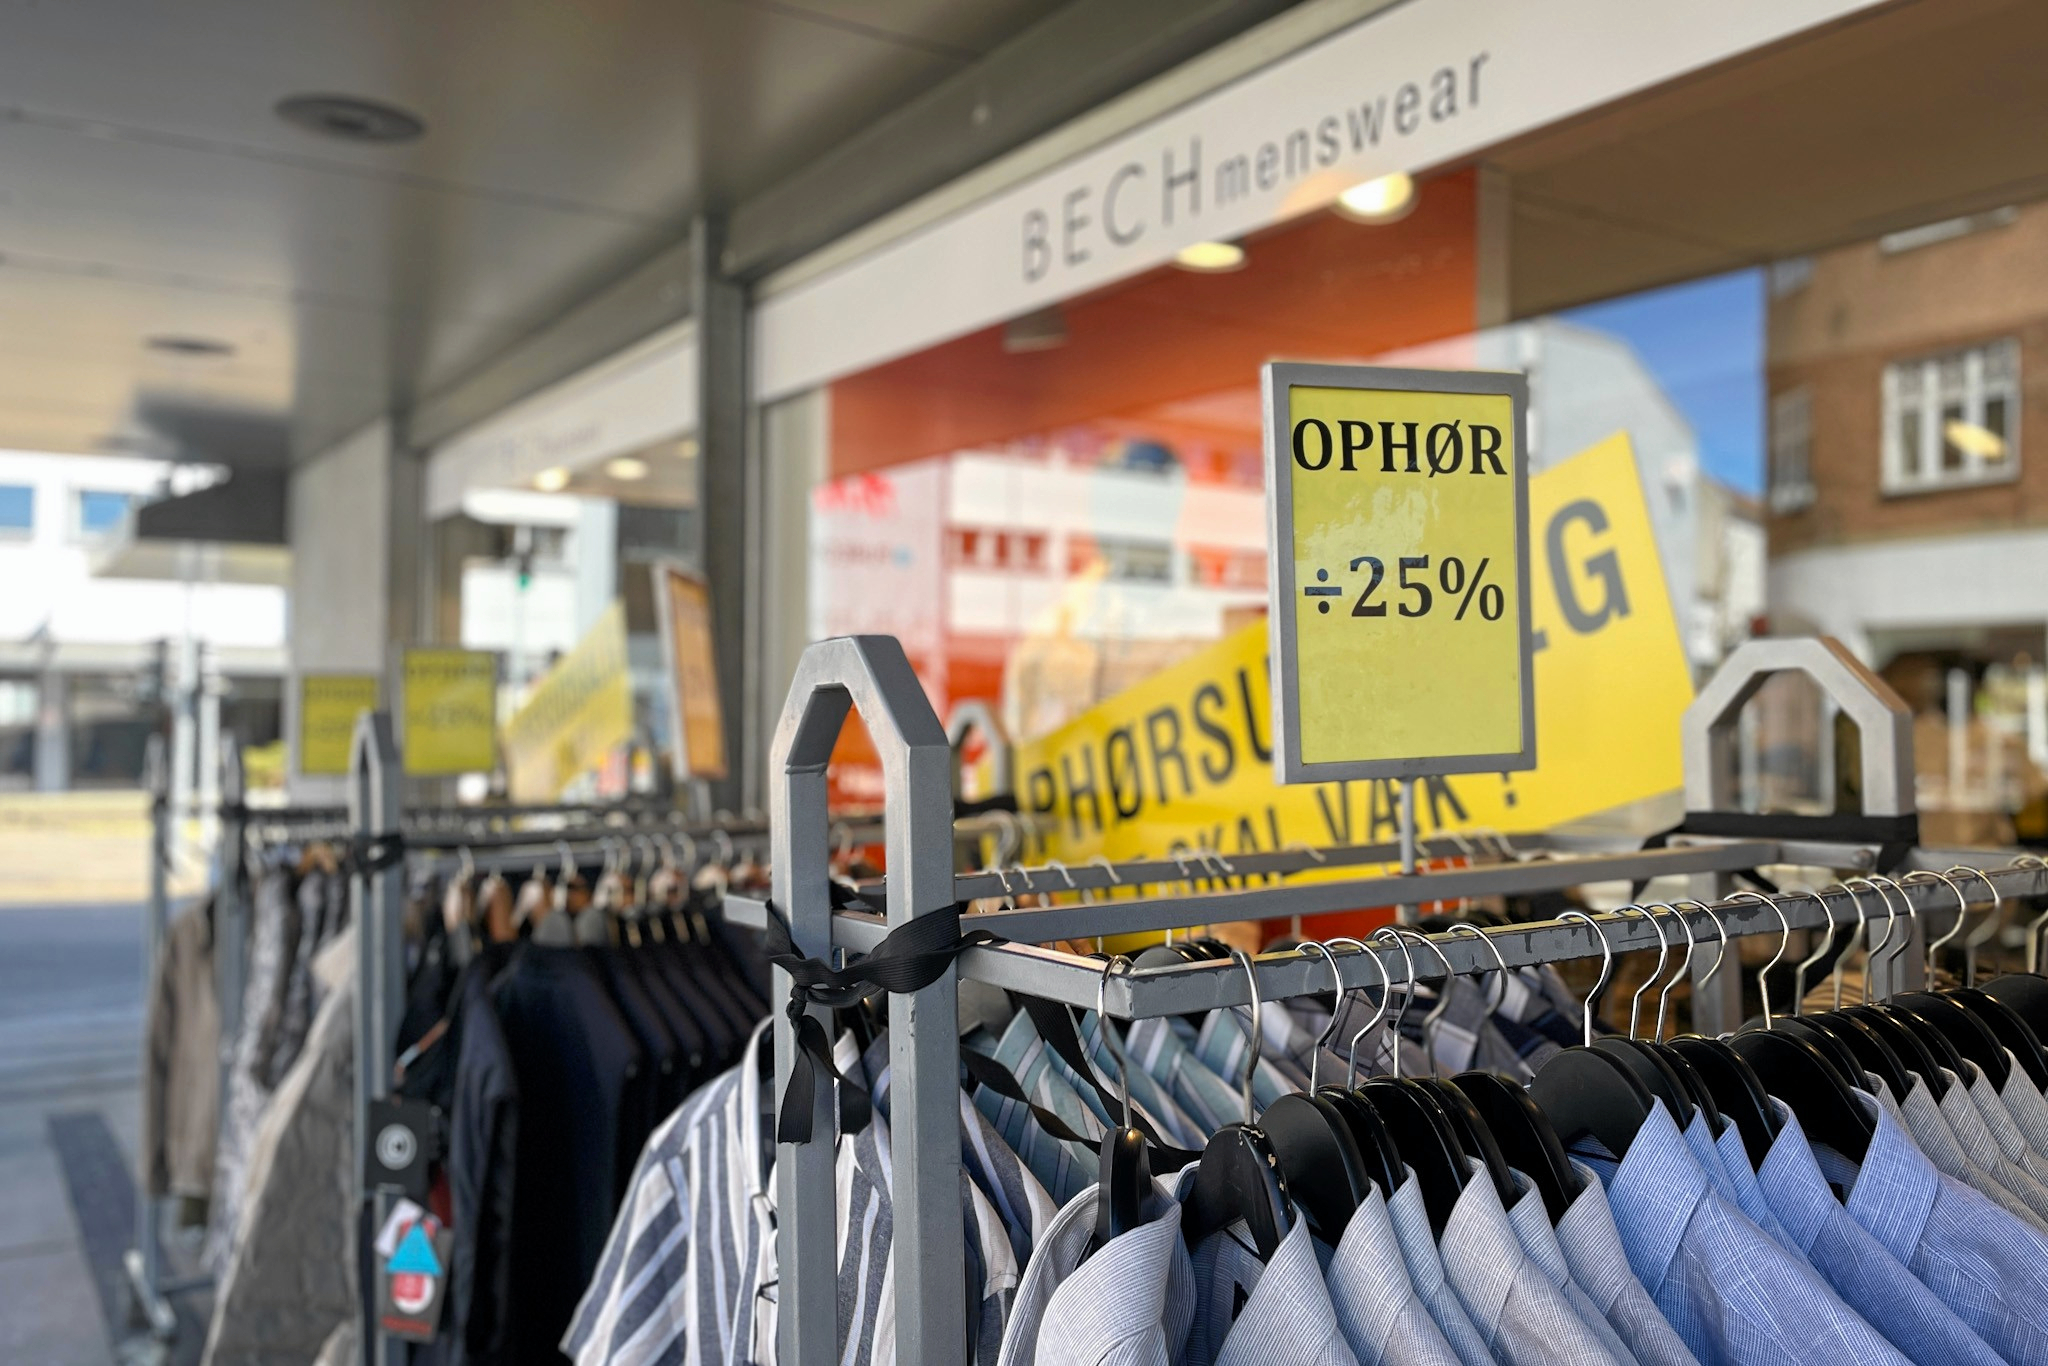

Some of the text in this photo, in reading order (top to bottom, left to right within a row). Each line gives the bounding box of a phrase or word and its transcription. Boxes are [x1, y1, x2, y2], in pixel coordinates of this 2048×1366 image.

[1021, 50, 1491, 285] BECH menswear
[1291, 417, 1508, 478] OPHØR
